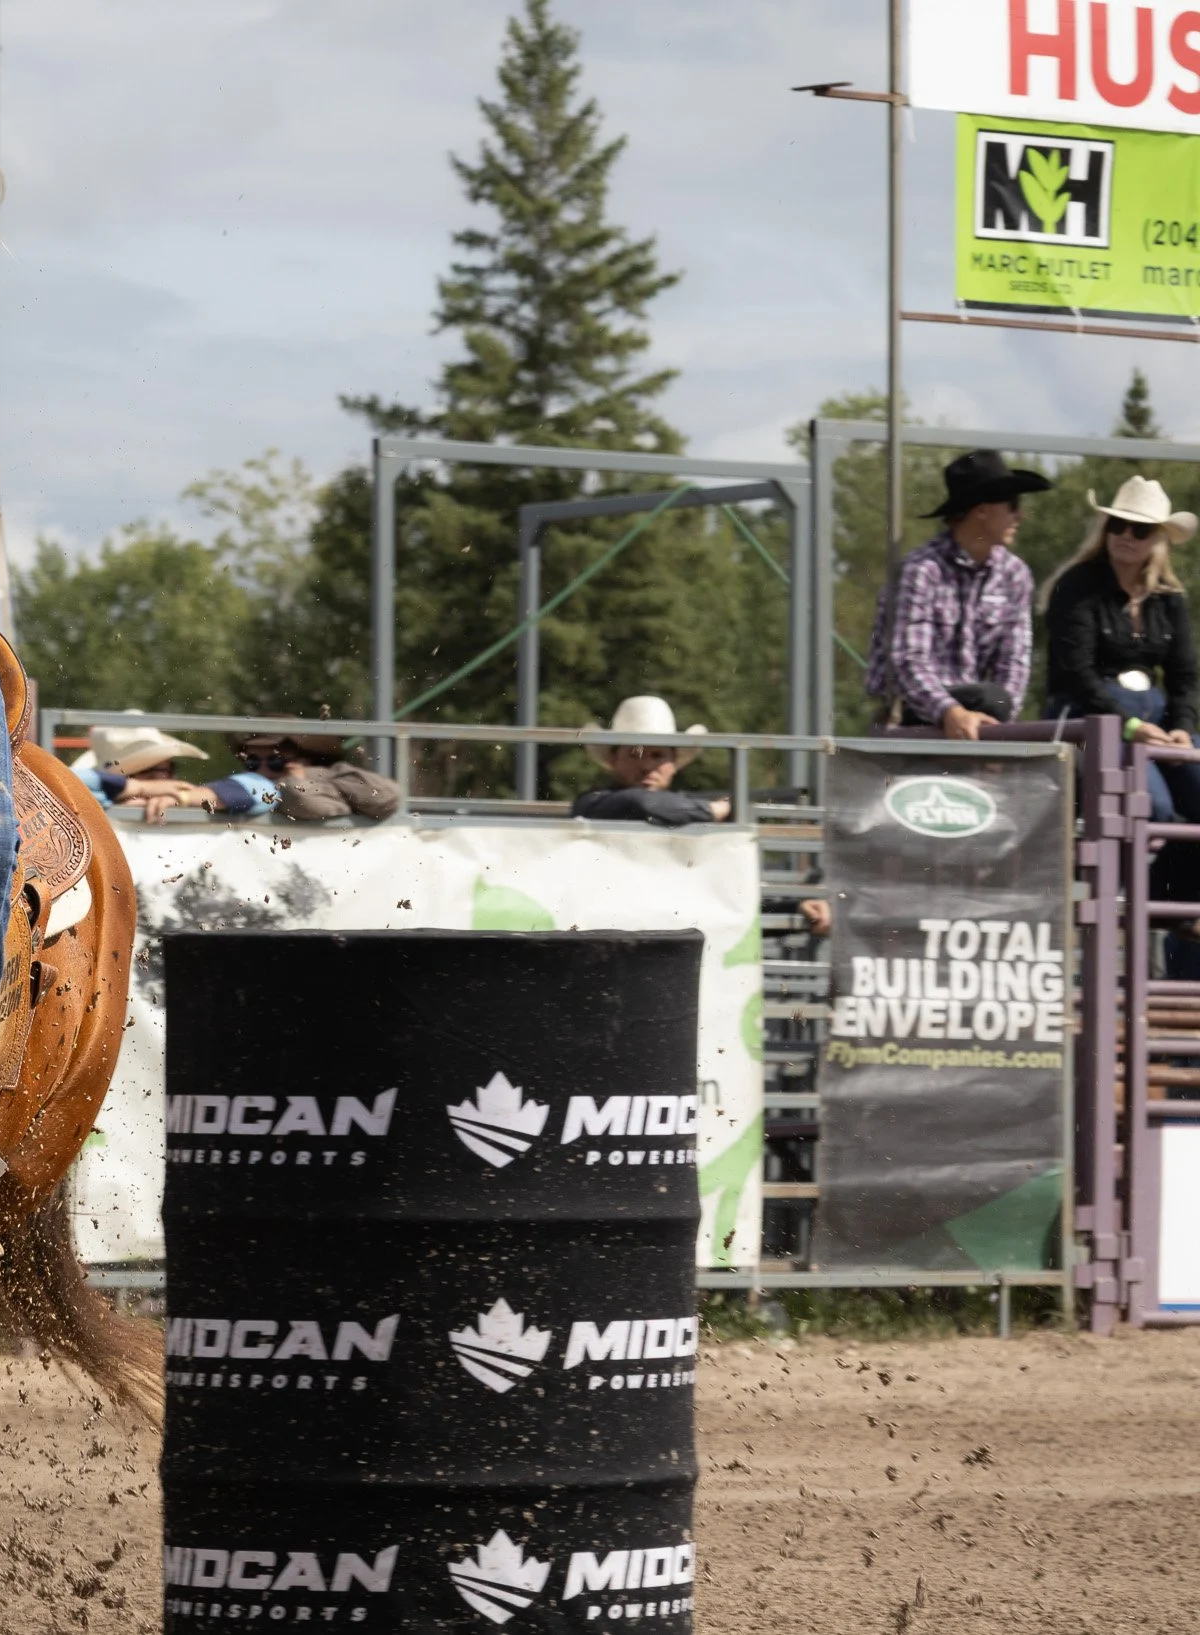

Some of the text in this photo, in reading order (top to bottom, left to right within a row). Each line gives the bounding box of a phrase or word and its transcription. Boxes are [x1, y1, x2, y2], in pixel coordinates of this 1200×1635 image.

[1036, 257, 1112, 281] HUTLET
[1143, 265, 1200, 287] mar
[905, 804, 979, 826] FLYNN
[919, 919, 1063, 962] TOTAL
[852, 957, 1064, 1001] BUILDING
[831, 997, 1064, 1042] ENVELOPE
[826, 1041, 1062, 1070] FlynnCompanies.com
